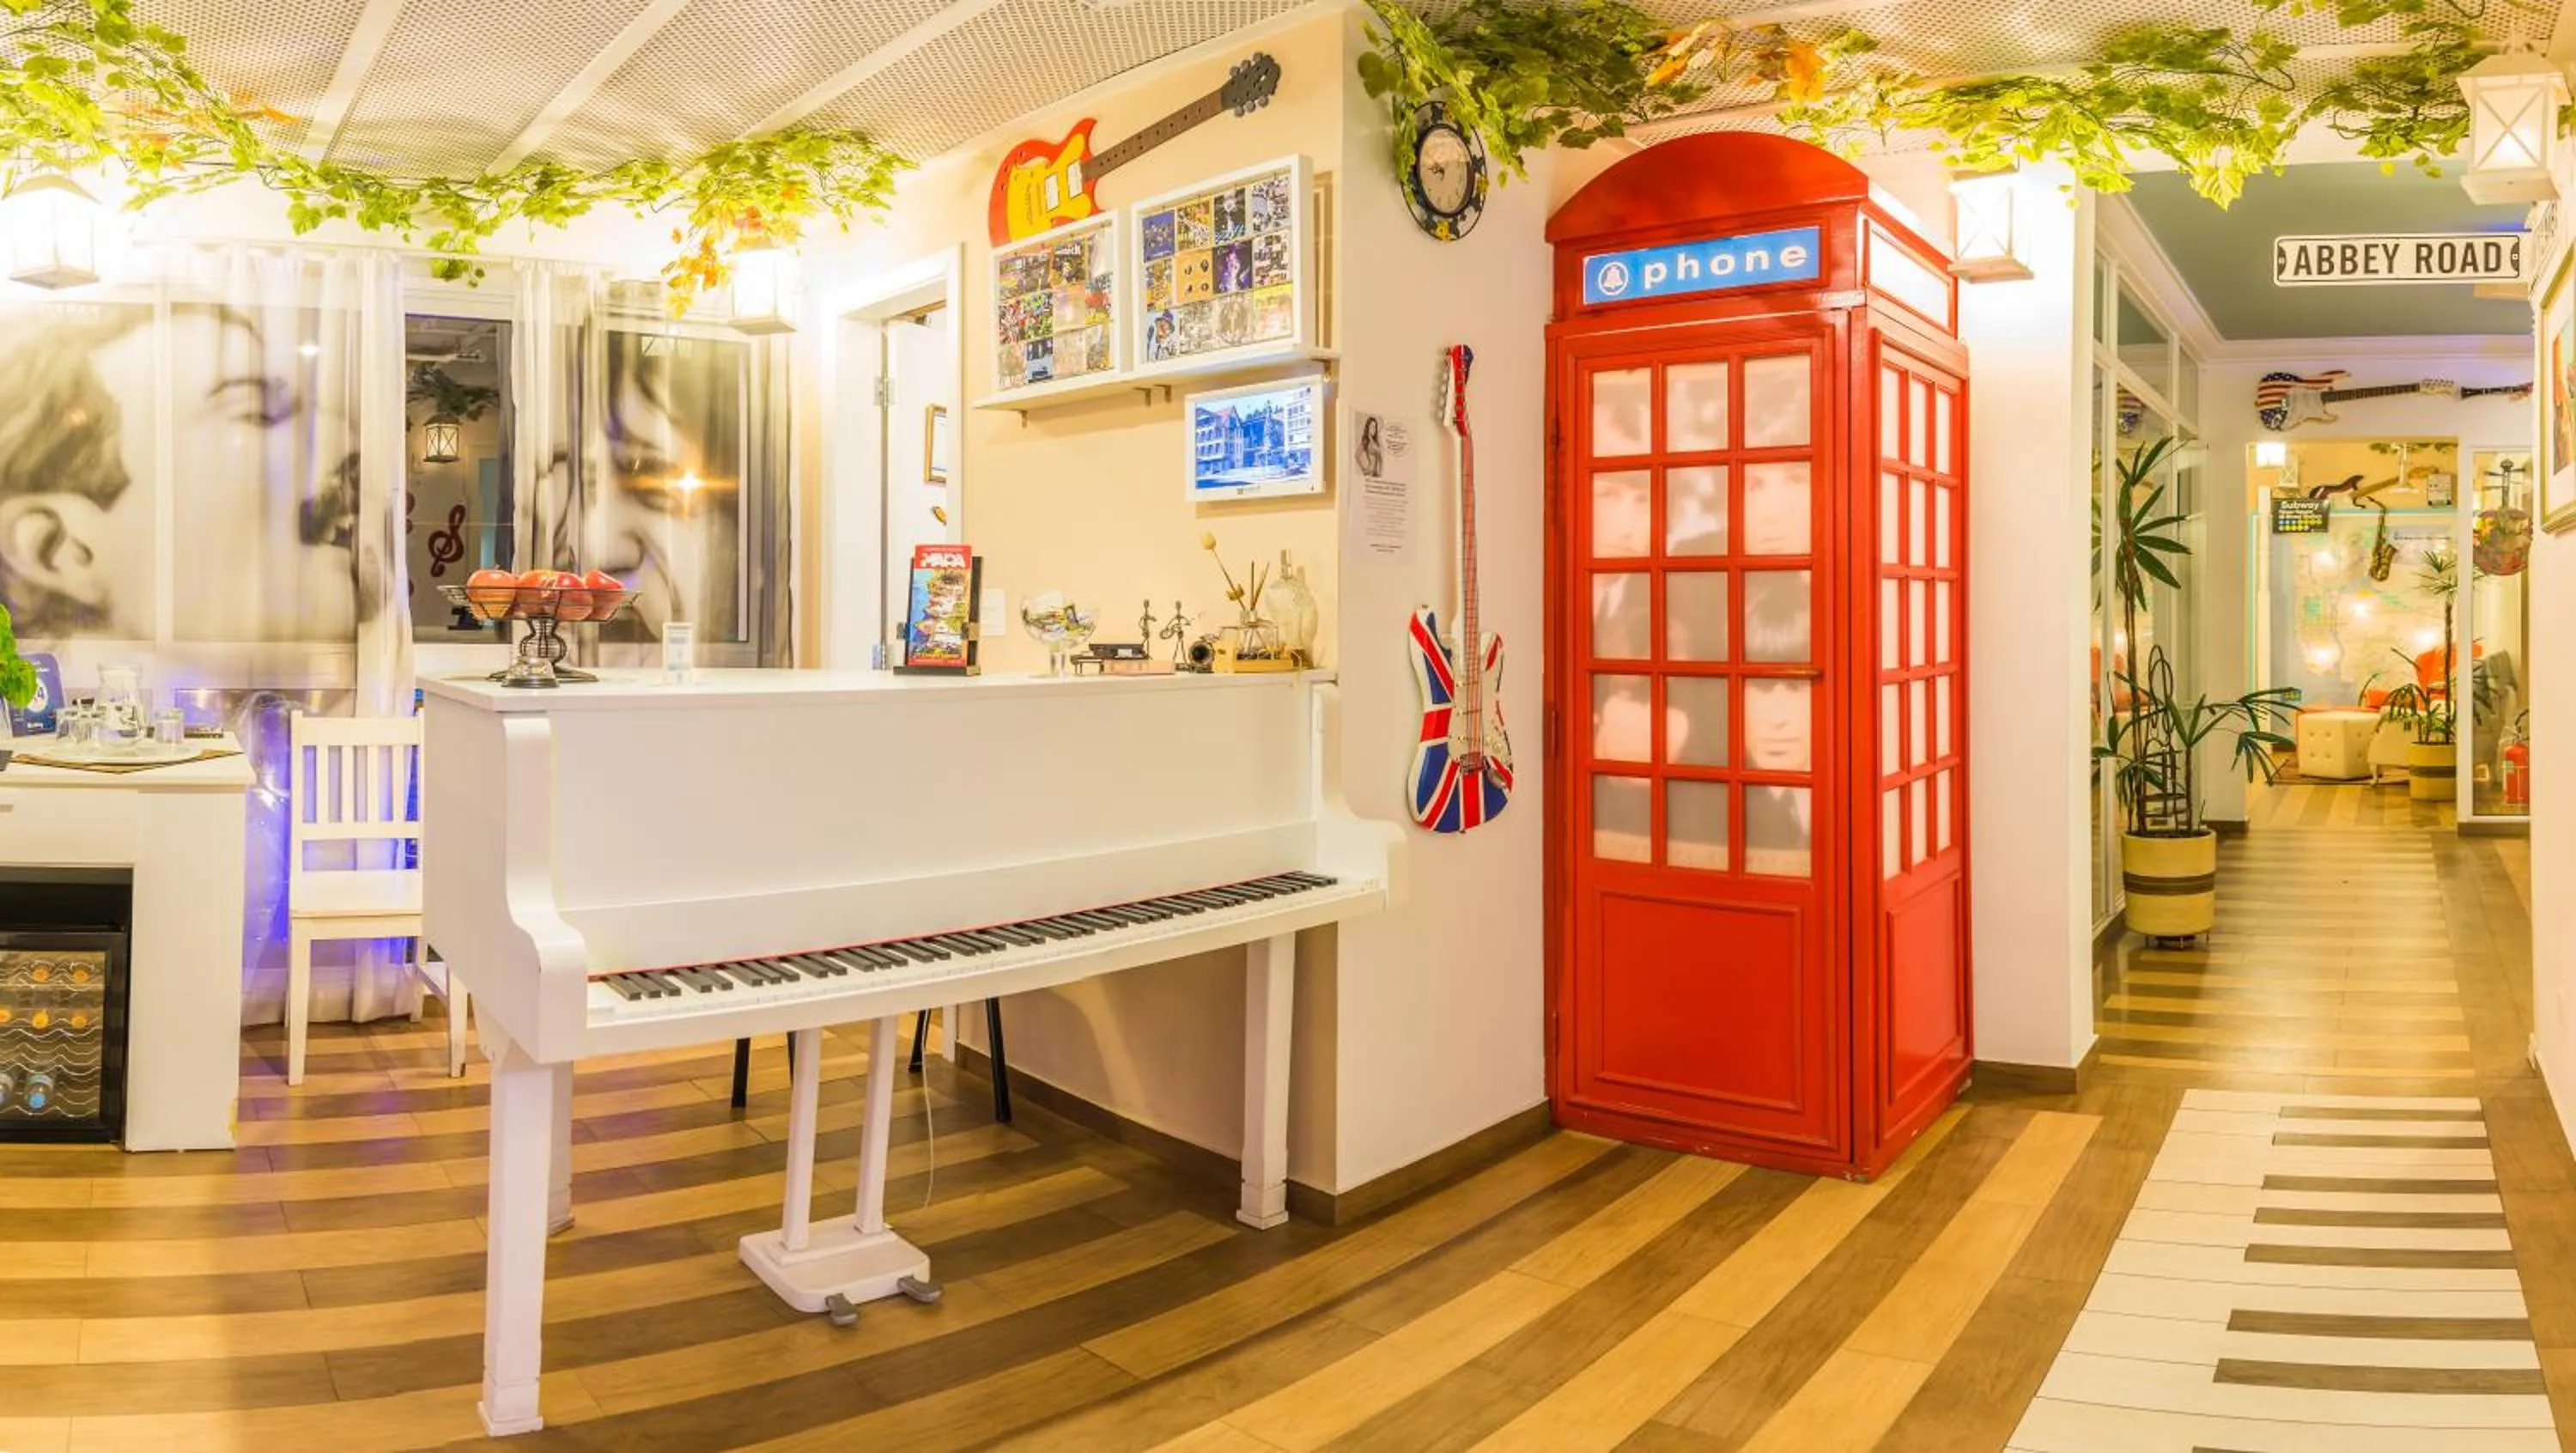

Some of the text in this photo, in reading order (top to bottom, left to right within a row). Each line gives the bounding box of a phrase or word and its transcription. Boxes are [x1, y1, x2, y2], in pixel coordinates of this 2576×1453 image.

[1643, 245, 1808, 289] phone
[2293, 241, 2502, 276] ABBEY ROAD
[2281, 500, 2319, 510] Subway
